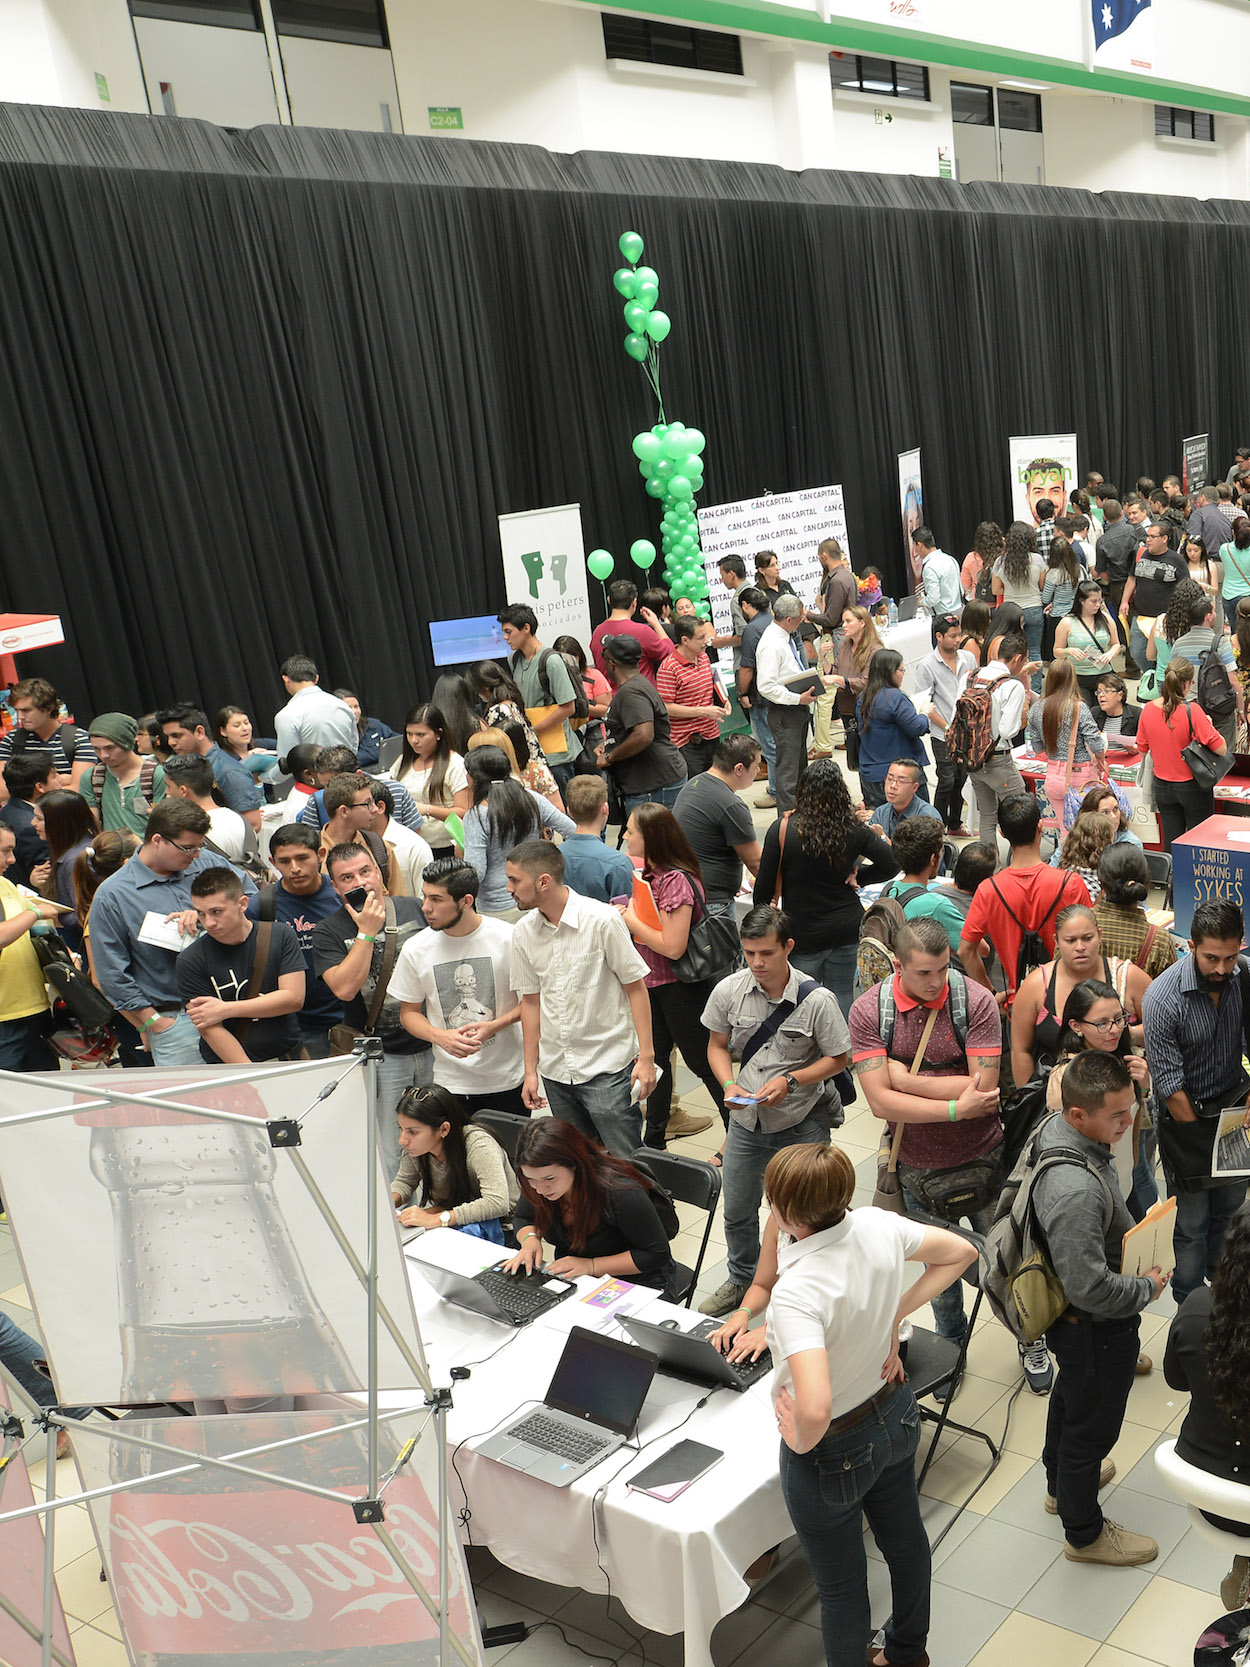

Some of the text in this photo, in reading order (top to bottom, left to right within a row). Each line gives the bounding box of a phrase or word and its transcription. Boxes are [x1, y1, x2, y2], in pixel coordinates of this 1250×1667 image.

[430, 116, 458, 126] C2-04
[1044, 455, 1071, 463] become
[1018, 465, 1072, 486] bryan
[699, 511, 714, 520] CAN
[716, 505, 744, 518] CAPITAL
[766, 496, 793, 508] CAPITAL
[800, 493, 812, 501] CAN
[814, 488, 840, 500] CAPITAL
[727, 522, 742, 531] CAN
[743, 516, 771, 528] CAPITAL
[778, 512, 791, 521] CAN
[791, 508, 817, 519] CAPITAL
[824, 504, 837, 512] CAN
[704, 519, 842, 553] CAN CAPITAL CAN CAPITAL CAN CAPITAL
[783, 544, 795, 553] CAN
[547, 596, 584, 616] peters
[1192, 848, 1229, 865] I STARTED
[1192, 864, 1244, 881] WORKING AT
[1194, 879, 1244, 907] SYKES
